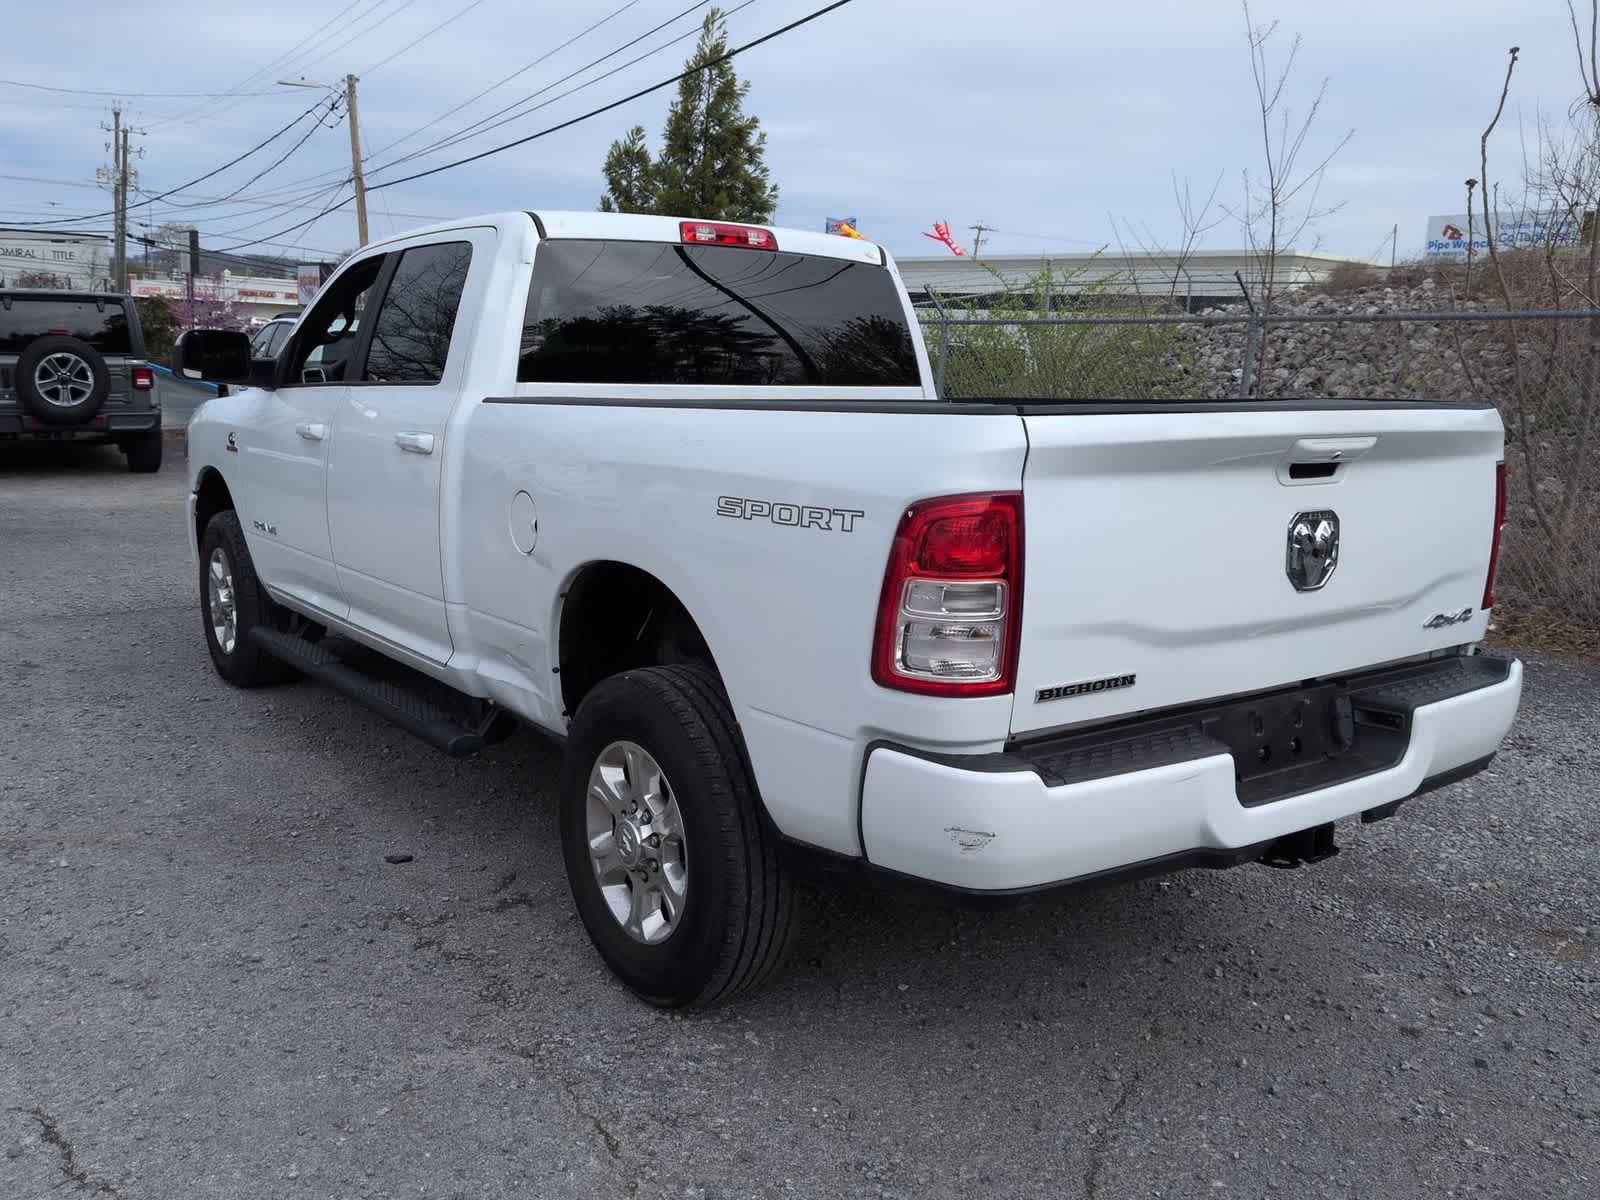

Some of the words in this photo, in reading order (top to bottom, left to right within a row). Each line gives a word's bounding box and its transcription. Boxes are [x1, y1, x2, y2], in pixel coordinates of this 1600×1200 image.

[52, 250, 75, 260] TITLE
[1428, 240, 1450, 251] Pipe
[716, 496, 865, 533] SPORT
[1037, 674, 1136, 701] BIGHORN
